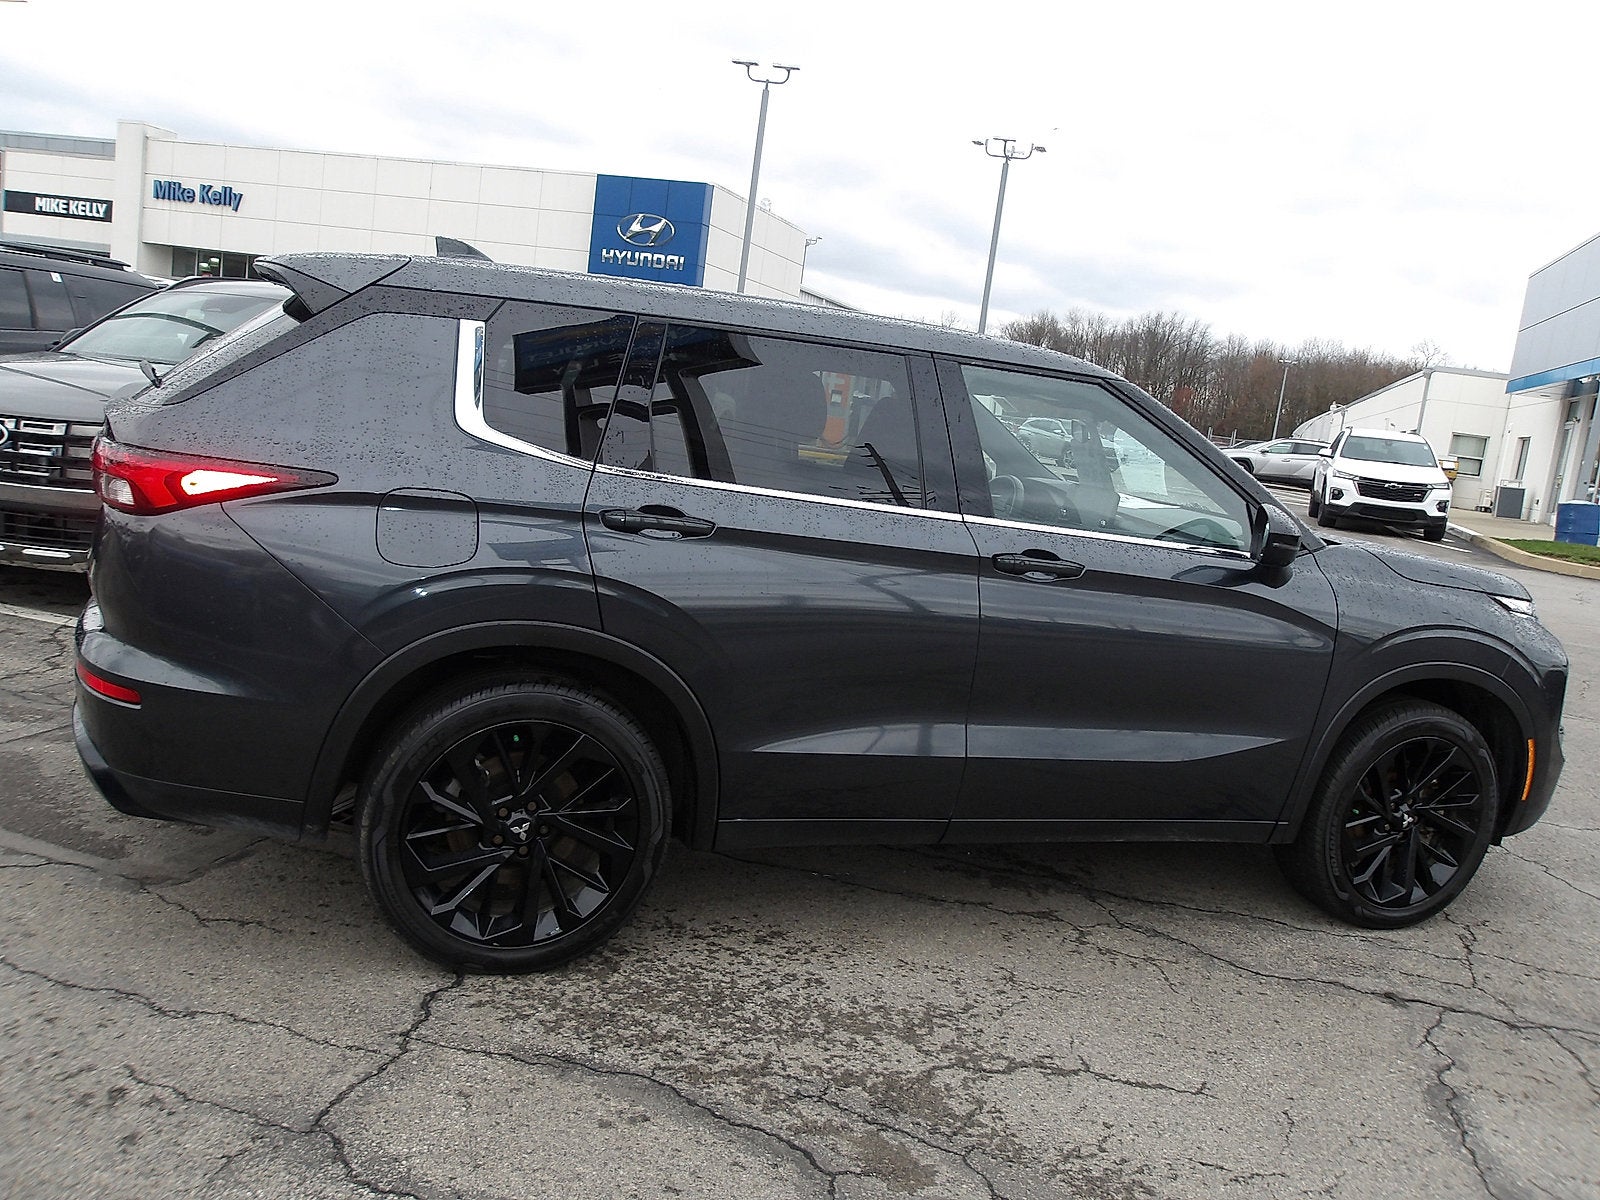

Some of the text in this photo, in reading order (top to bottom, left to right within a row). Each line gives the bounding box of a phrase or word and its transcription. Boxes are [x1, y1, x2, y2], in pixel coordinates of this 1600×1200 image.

[34, 196, 108, 218] MIKE KELLY
[153, 179, 243, 212] Mike Kelly
[601, 248, 685, 271] HYUNDAI
